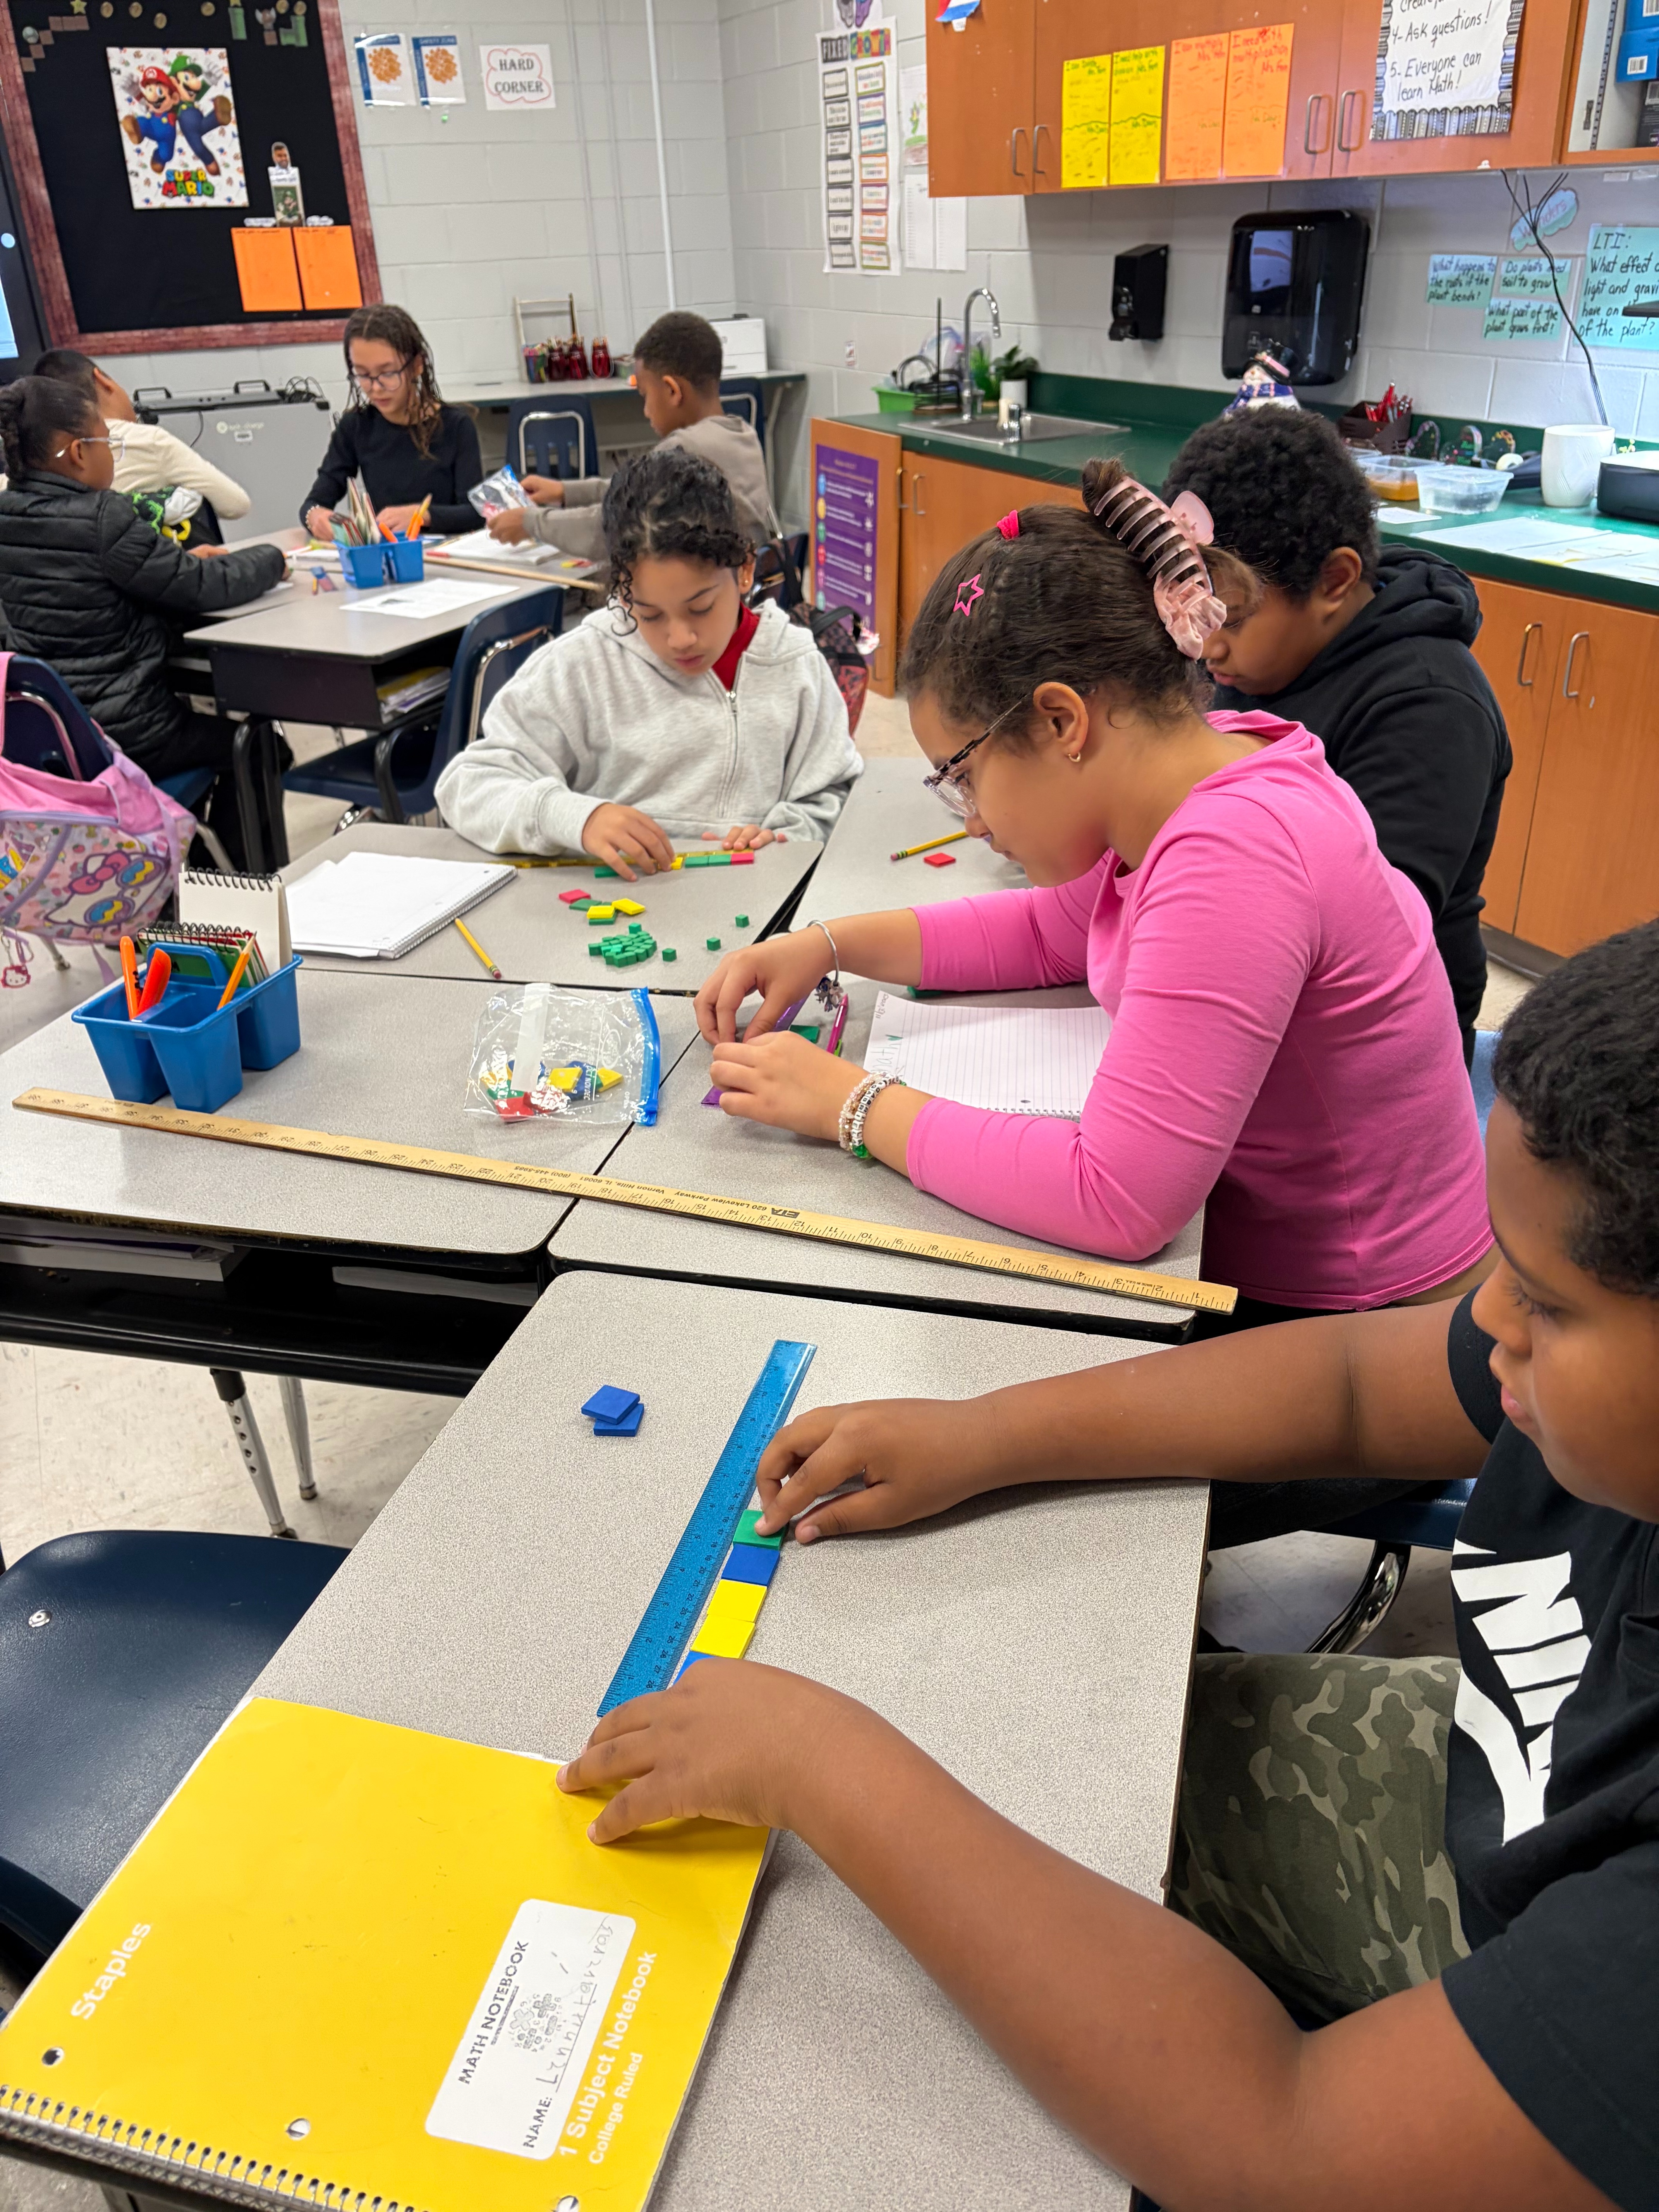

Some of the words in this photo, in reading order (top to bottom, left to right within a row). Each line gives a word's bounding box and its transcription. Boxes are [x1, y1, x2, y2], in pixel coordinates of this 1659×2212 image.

[1405, 22, 1428, 42] Ask
[1431, 1, 1491, 48] questions!
[499, 58, 534, 71] HARD
[1405, 56, 1456, 79] Everyone
[1463, 52, 1481, 67] can
[494, 81, 544, 94] CORNER
[1398, 82, 1423, 101] learn
[166, 169, 207, 182] SUPER
[161, 180, 215, 198] MARIO
[1590, 254, 1618, 273] What
[1609, 277, 1630, 295] and
[1606, 307, 1619, 317] on
[1595, 318, 1613, 337] the
[514, 1165, 549, 1175] 445-5985
[637, 1185, 665, 1195] Vernon
[674, 1191, 709, 1202] Parkway
[712, 1198, 750, 1209] Lakeview
[699, 1566, 707, 1574] 20
[686, 1593, 694, 1602] 22
[680, 1607, 689, 1616] 23
[674, 1621, 682, 1629] 24
[666, 1635, 675, 1644] 25
[660, 1649, 669, 1659] 26
[654, 1665, 662, 1674] 27
[646, 1680, 655, 1689] 28
[70, 1922, 153, 2021] Staples
[603, 1951, 658, 2050] Notebook
[458, 2034, 489, 2085] MATH
[481, 1940, 529, 2030] NOTEBOOK
[566, 2053, 617, 2139] Subject
[588, 2102, 625, 2165] College
[614, 2052, 644, 2099] Ruled
[522, 2096, 553, 2148] NAME:
[559, 2145, 578, 2157] 1
